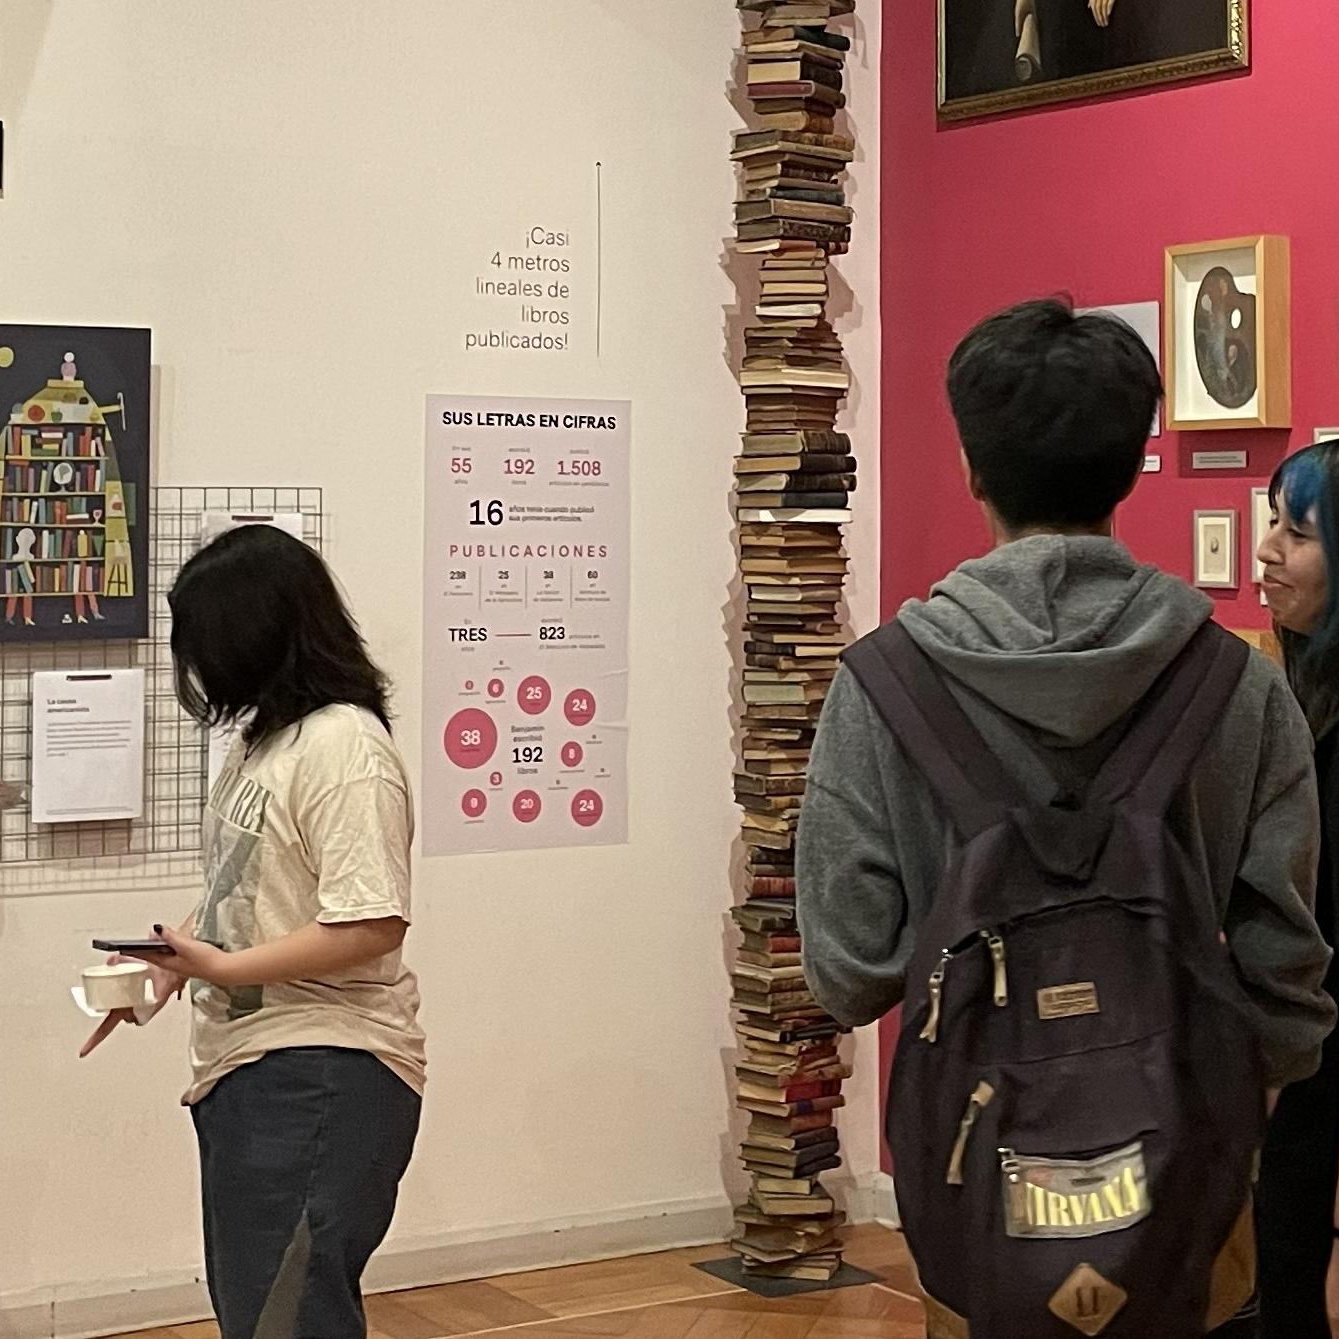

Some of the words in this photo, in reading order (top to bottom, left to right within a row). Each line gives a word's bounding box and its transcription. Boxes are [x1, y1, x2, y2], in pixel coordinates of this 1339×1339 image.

[525, 226, 570, 249] ¡Casi
[490, 251, 502, 269] 4
[507, 255, 570, 272] metros
[476, 276, 543, 297] lineales
[547, 280, 570, 298] de
[521, 305, 570, 324] libros
[465, 330, 569, 351] publicados!
[442, 411, 473, 425] SUS
[476, 413, 536, 427] LETRAS
[539, 415, 559, 428] EN
[562, 415, 617, 430] CIFRAS
[451, 457, 472, 474] 55
[504, 459, 536, 475] 192
[557, 460, 602, 476] 1.508
[469, 499, 504, 526] 16
[449, 544, 608, 558] PUBLICACIONES
[448, 627, 488, 642] TRES
[539, 626, 566, 640] 823
[526, 687, 543, 700] 25
[572, 699, 588, 711] 24
[460, 729, 481, 746] 38
[512, 746, 544, 764] 192
[579, 799, 595, 812] 24
